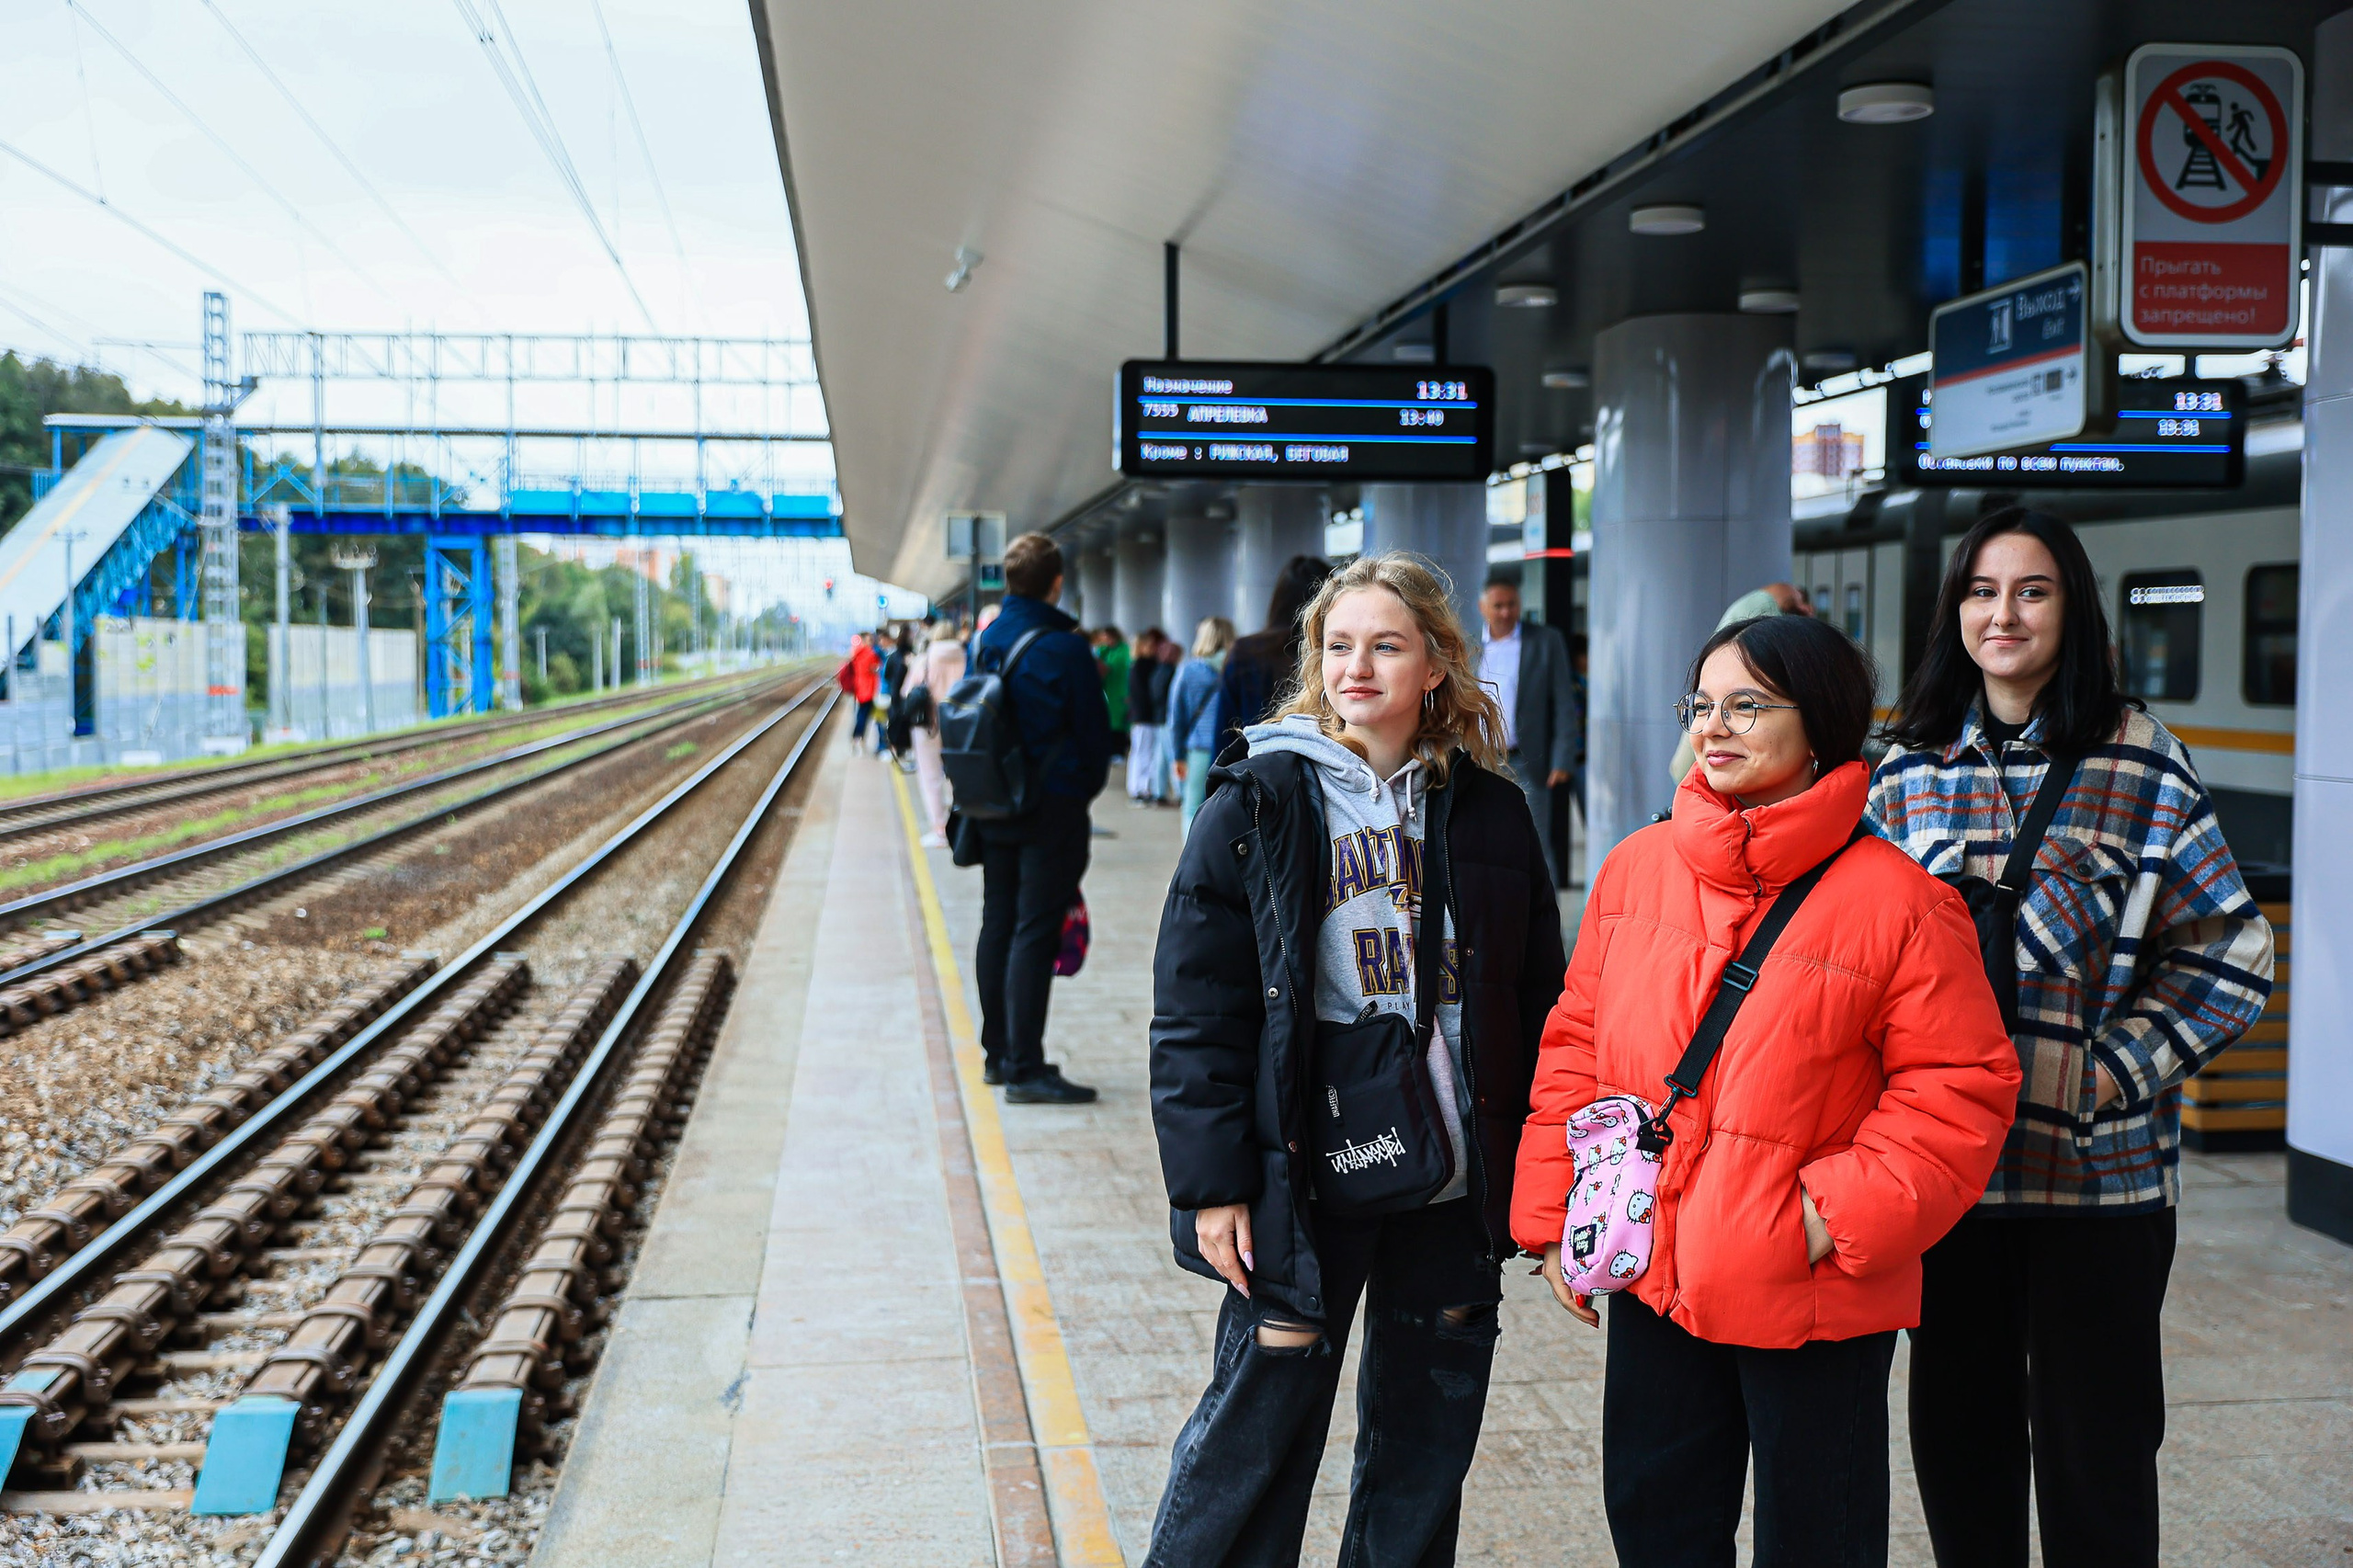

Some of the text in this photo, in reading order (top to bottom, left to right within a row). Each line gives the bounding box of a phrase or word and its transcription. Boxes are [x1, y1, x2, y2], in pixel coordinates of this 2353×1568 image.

[2140, 256, 2222, 277] Прыгать
[2139, 281, 2268, 302] с платформы
[2140, 307, 2256, 325] запрещено!
[1143, 376, 1468, 400] Назначение 13:31
[2174, 392, 2223, 412] 13:31
[1187, 405, 1268, 424] АПРЕЛЕВКА
[1399, 409, 1444, 426] 13:40
[1141, 443, 1188, 460] Кроме
[1286, 445, 1348, 461] БЕГОВАЯ
[1998, 456, 2018, 471] по
